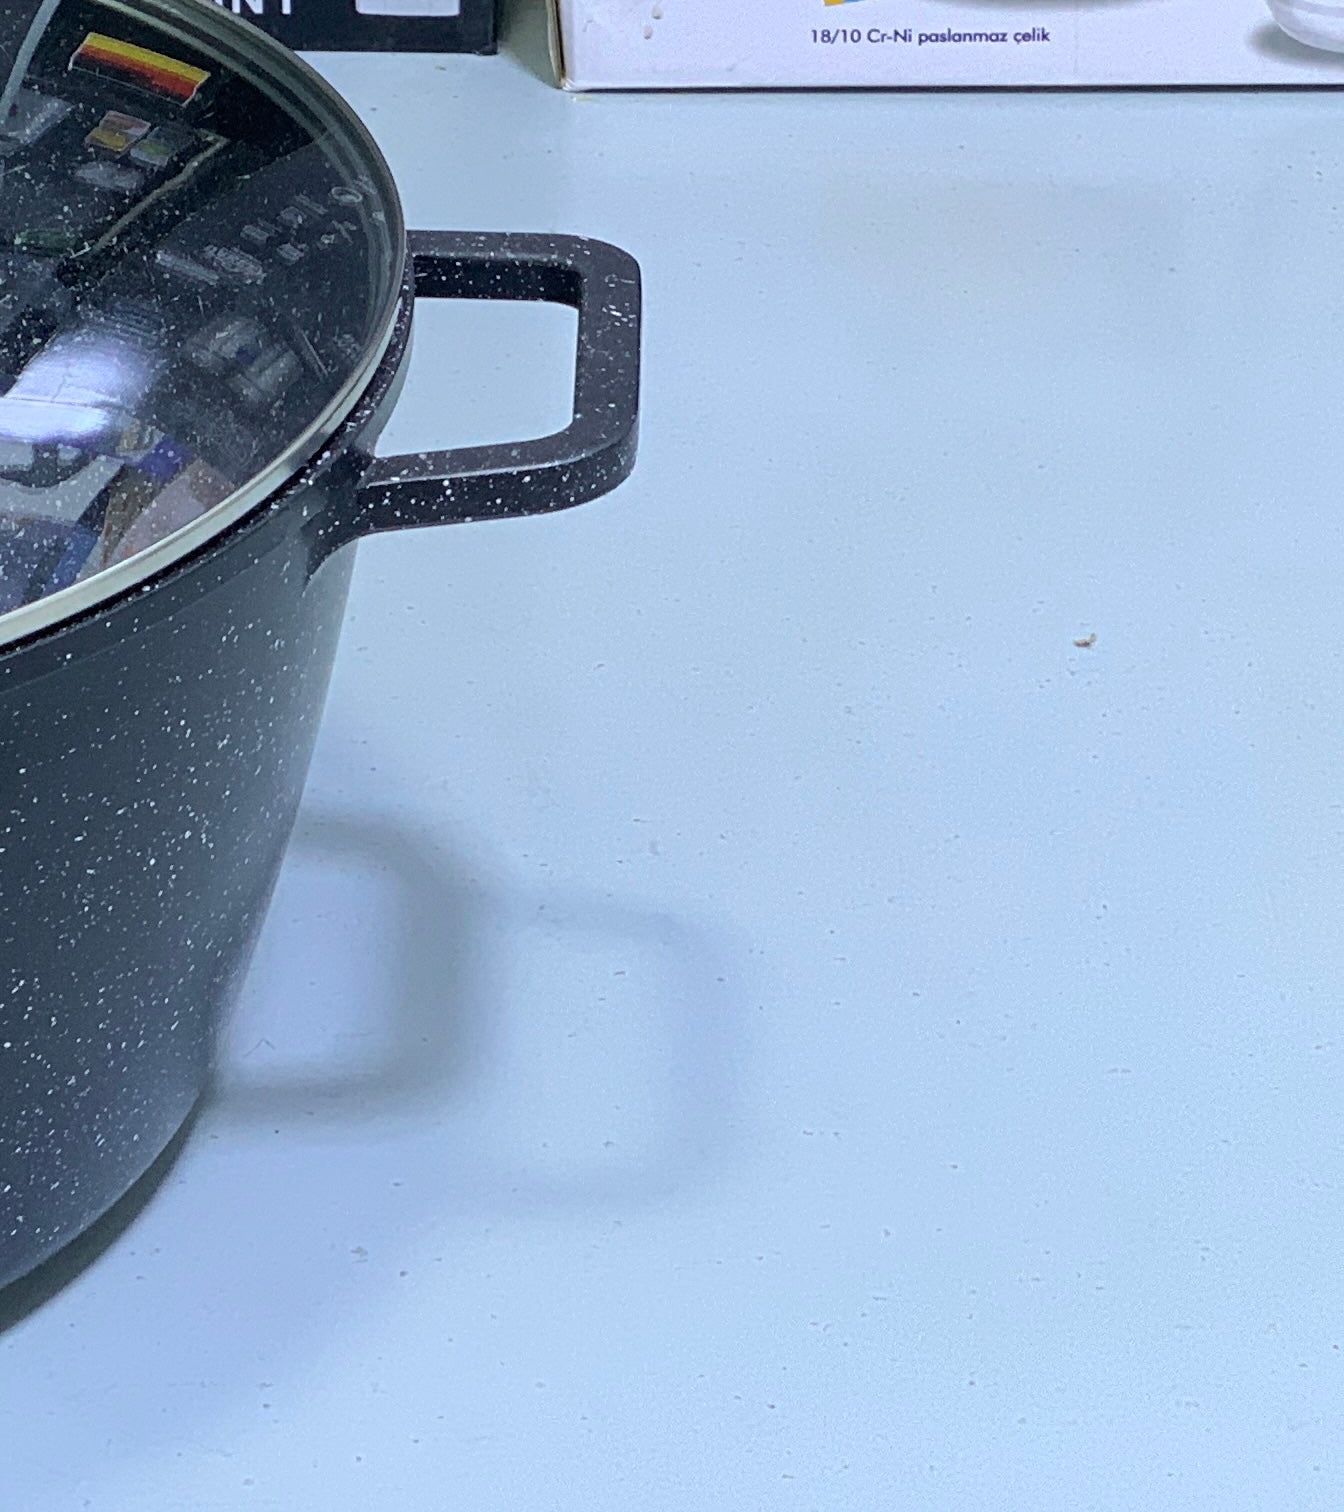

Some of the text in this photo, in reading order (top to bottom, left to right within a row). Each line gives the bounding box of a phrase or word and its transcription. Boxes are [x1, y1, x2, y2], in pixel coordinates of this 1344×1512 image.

[811, 27, 1051, 46] 18/10 Cr-Ni paslanmaz çelik
